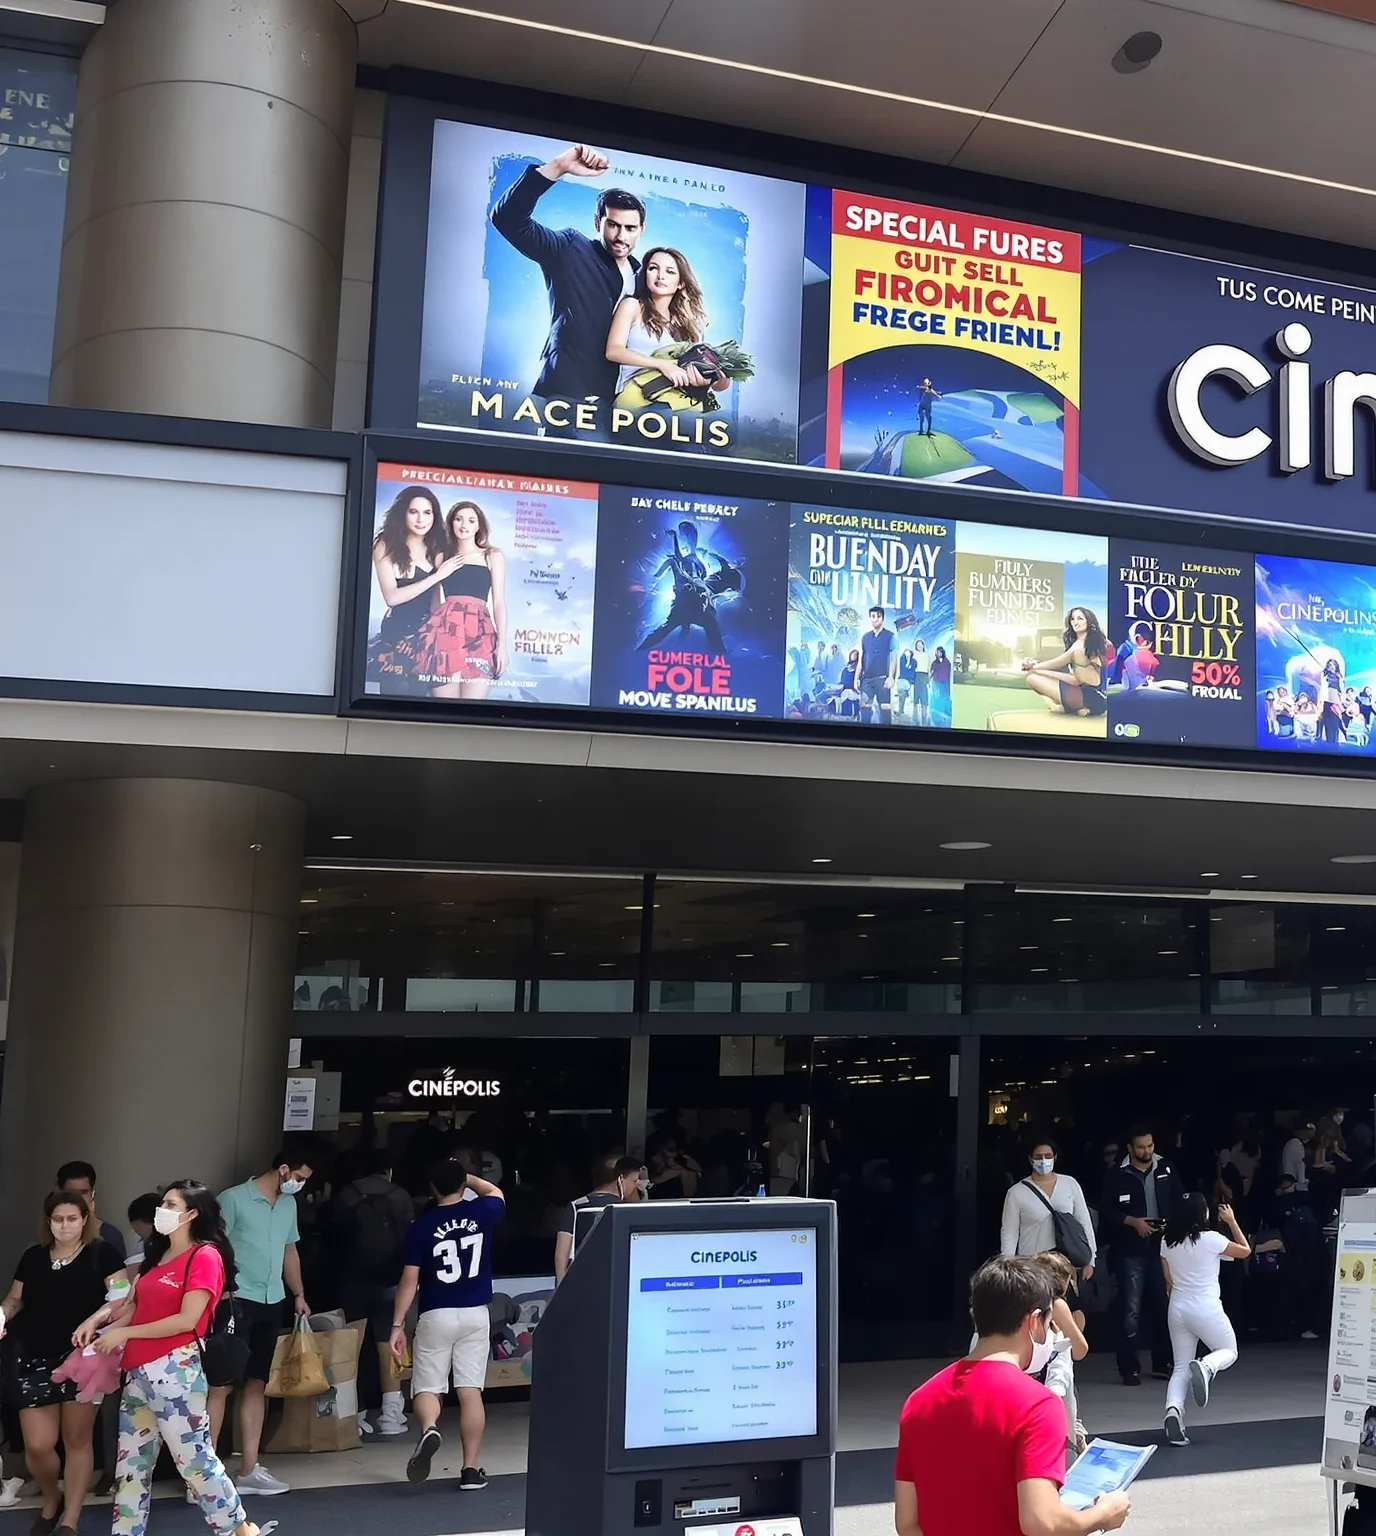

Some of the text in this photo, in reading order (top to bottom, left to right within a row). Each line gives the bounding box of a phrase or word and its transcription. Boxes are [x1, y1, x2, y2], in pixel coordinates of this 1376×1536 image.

[845, 204, 1064, 265] SPECIAL FURES
[894, 250, 1024, 287] GUIT SELL
[854, 268, 1058, 324] FIROMICAL
[1216, 276, 1258, 303] TUS
[1262, 285, 1326, 316] COME
[853, 301, 1061, 352] FREGE FRIENL!
[611, 409, 731, 448] POLIS
[809, 532, 942, 578] BUENDAY
[1124, 583, 1244, 627] FOLUR
[647, 664, 731, 695] FOLE
[1191, 661, 1241, 686] 50%
[619, 690, 673, 708] MOVE
[408, 1068, 500, 1097] CINÉPOLIS
[432, 1232, 484, 1284] 37
